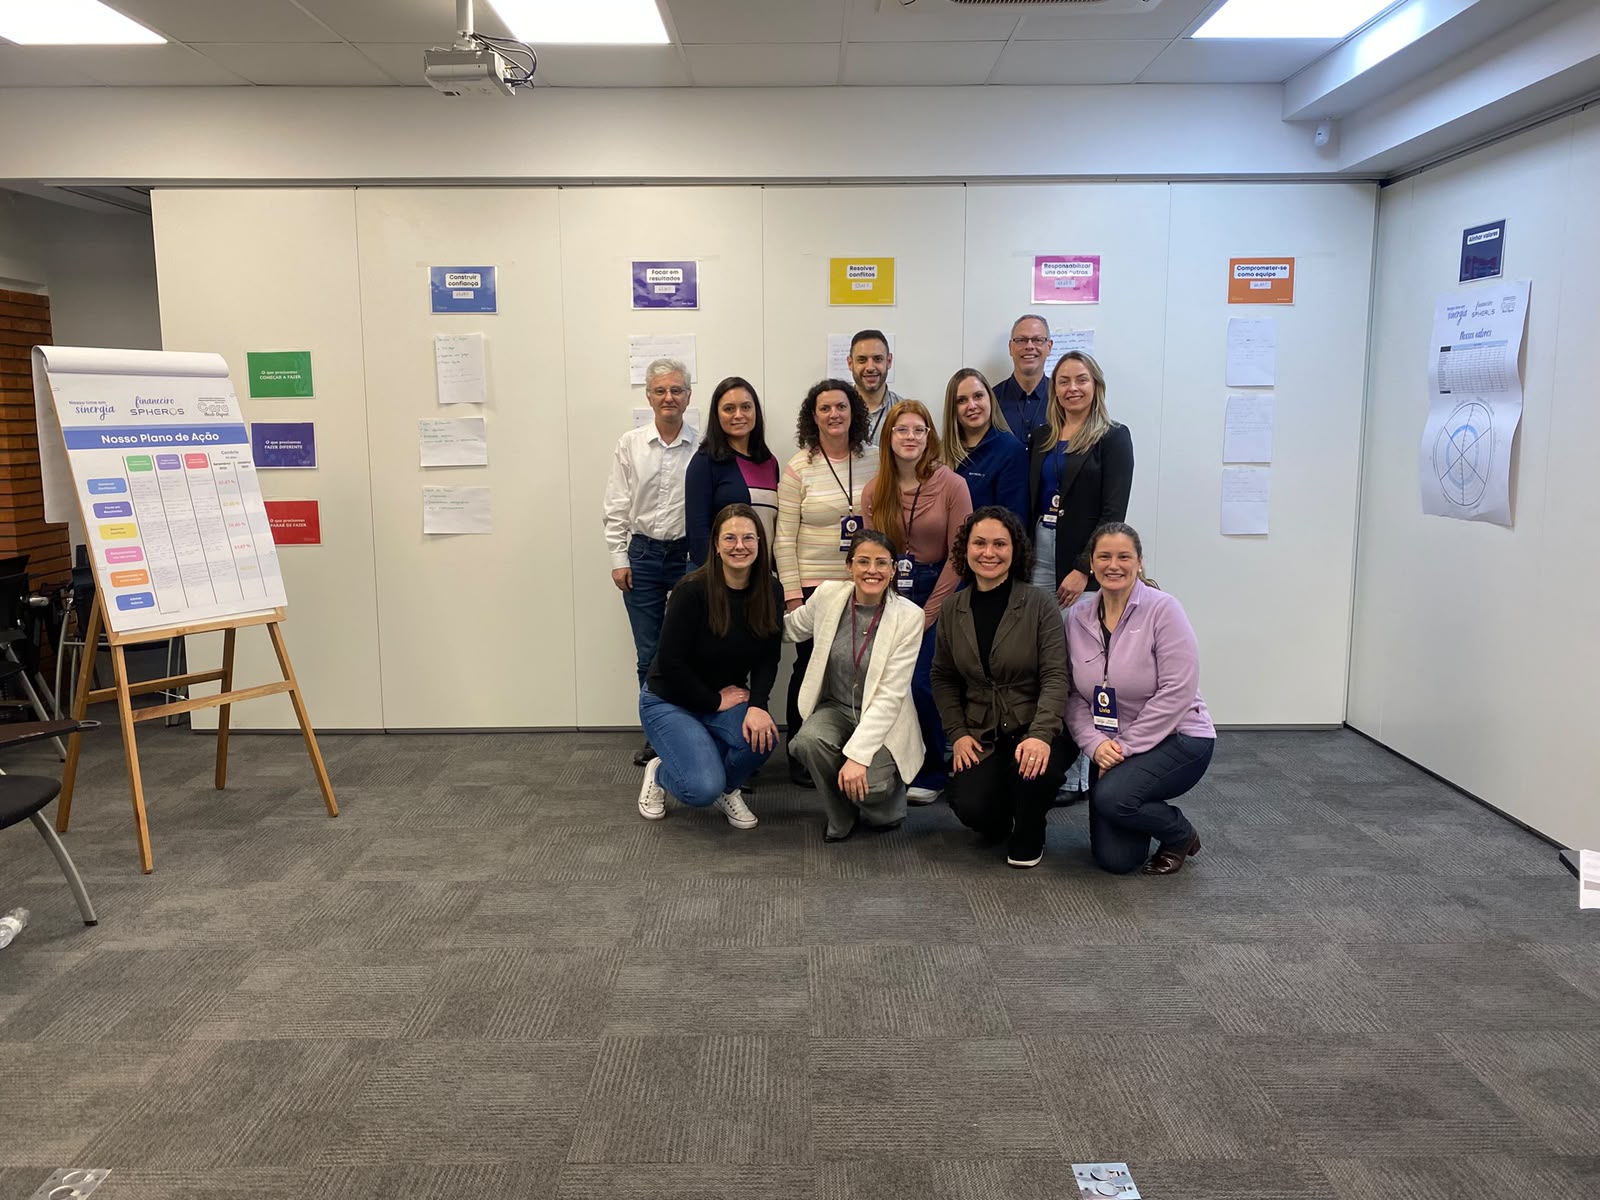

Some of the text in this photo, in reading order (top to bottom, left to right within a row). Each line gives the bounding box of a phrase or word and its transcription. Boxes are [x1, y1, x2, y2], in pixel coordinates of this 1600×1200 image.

[135, 395, 174, 408] financeiro
[75, 405, 116, 421] sinergia
[130, 408, 185, 416] SPHEROS
[101, 431, 220, 445] Nosso Plano de Ação
